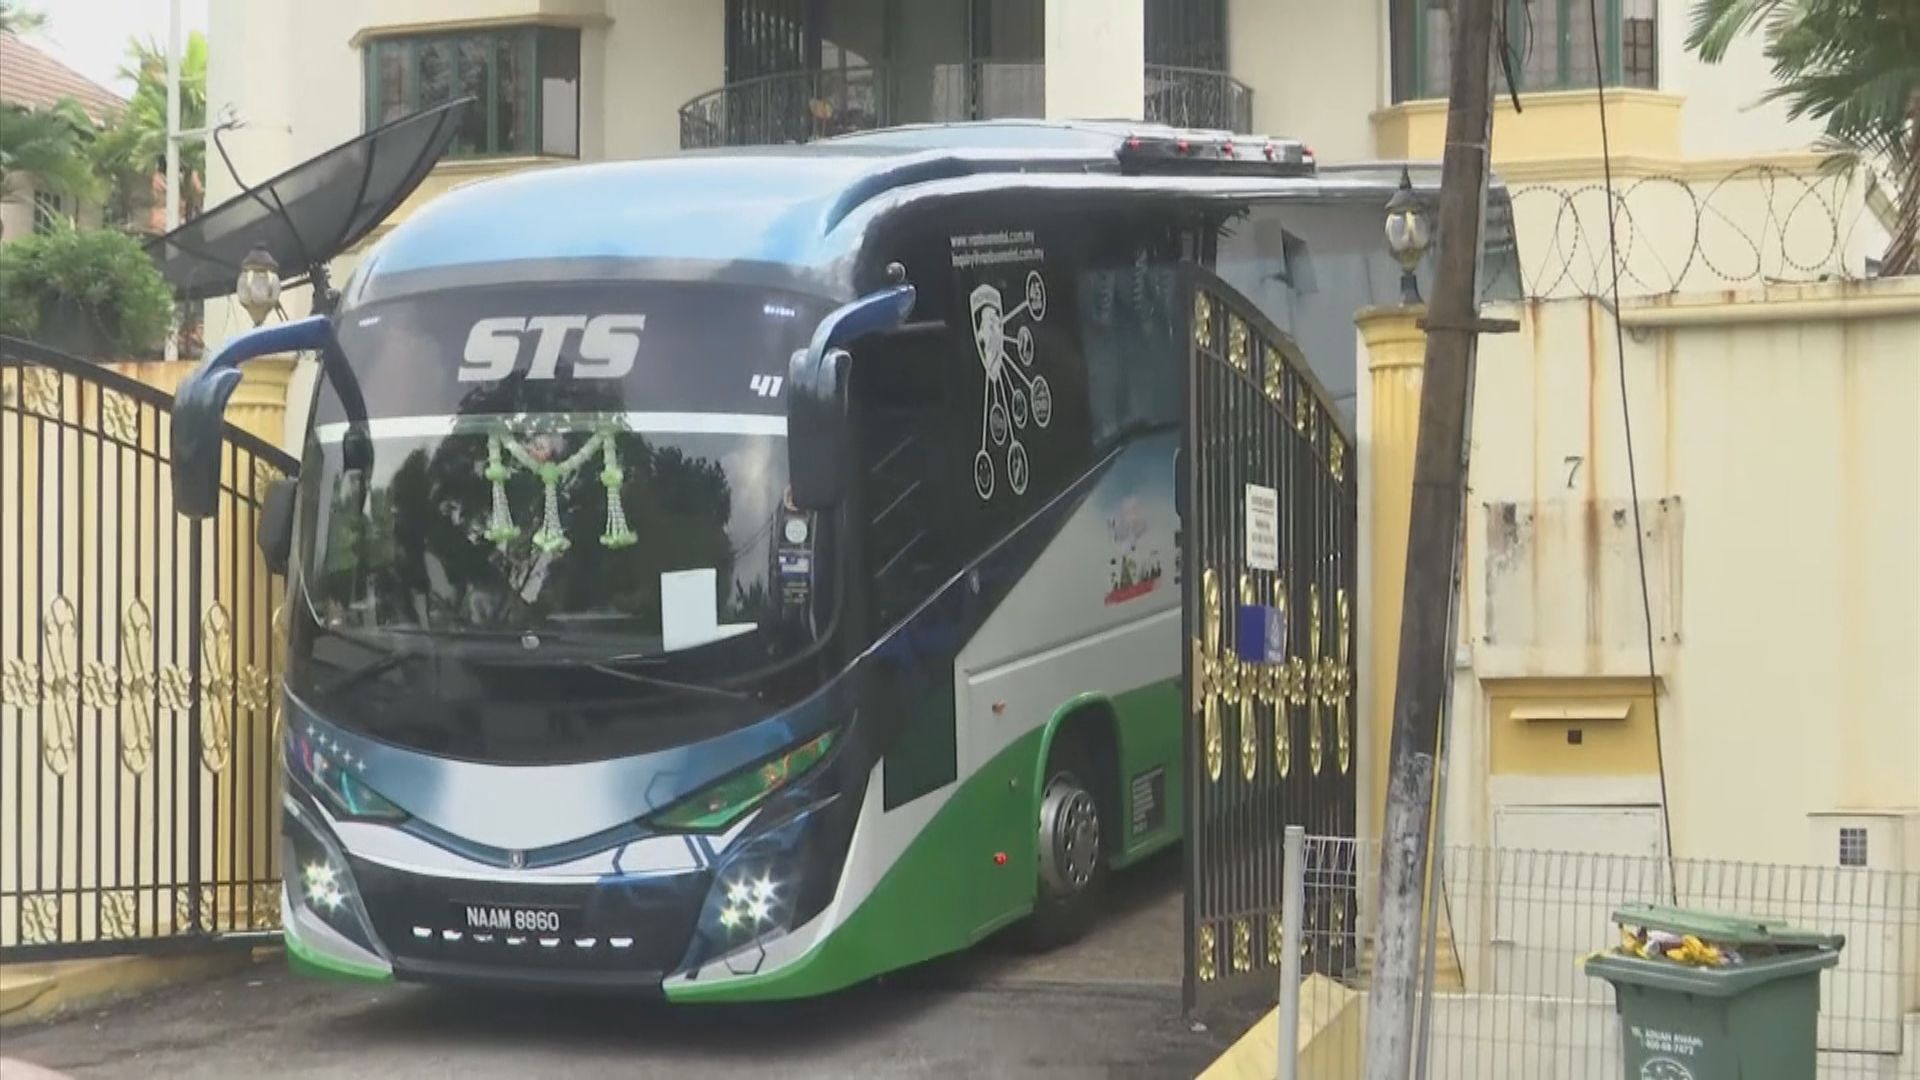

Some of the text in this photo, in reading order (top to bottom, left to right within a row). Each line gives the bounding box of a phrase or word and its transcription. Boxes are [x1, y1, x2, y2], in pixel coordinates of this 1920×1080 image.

[459, 314, 645, 381] STS
[749, 373, 784, 398] 41
[1564, 456, 1584, 489] 7
[466, 906, 560, 931] NAAM 8860
